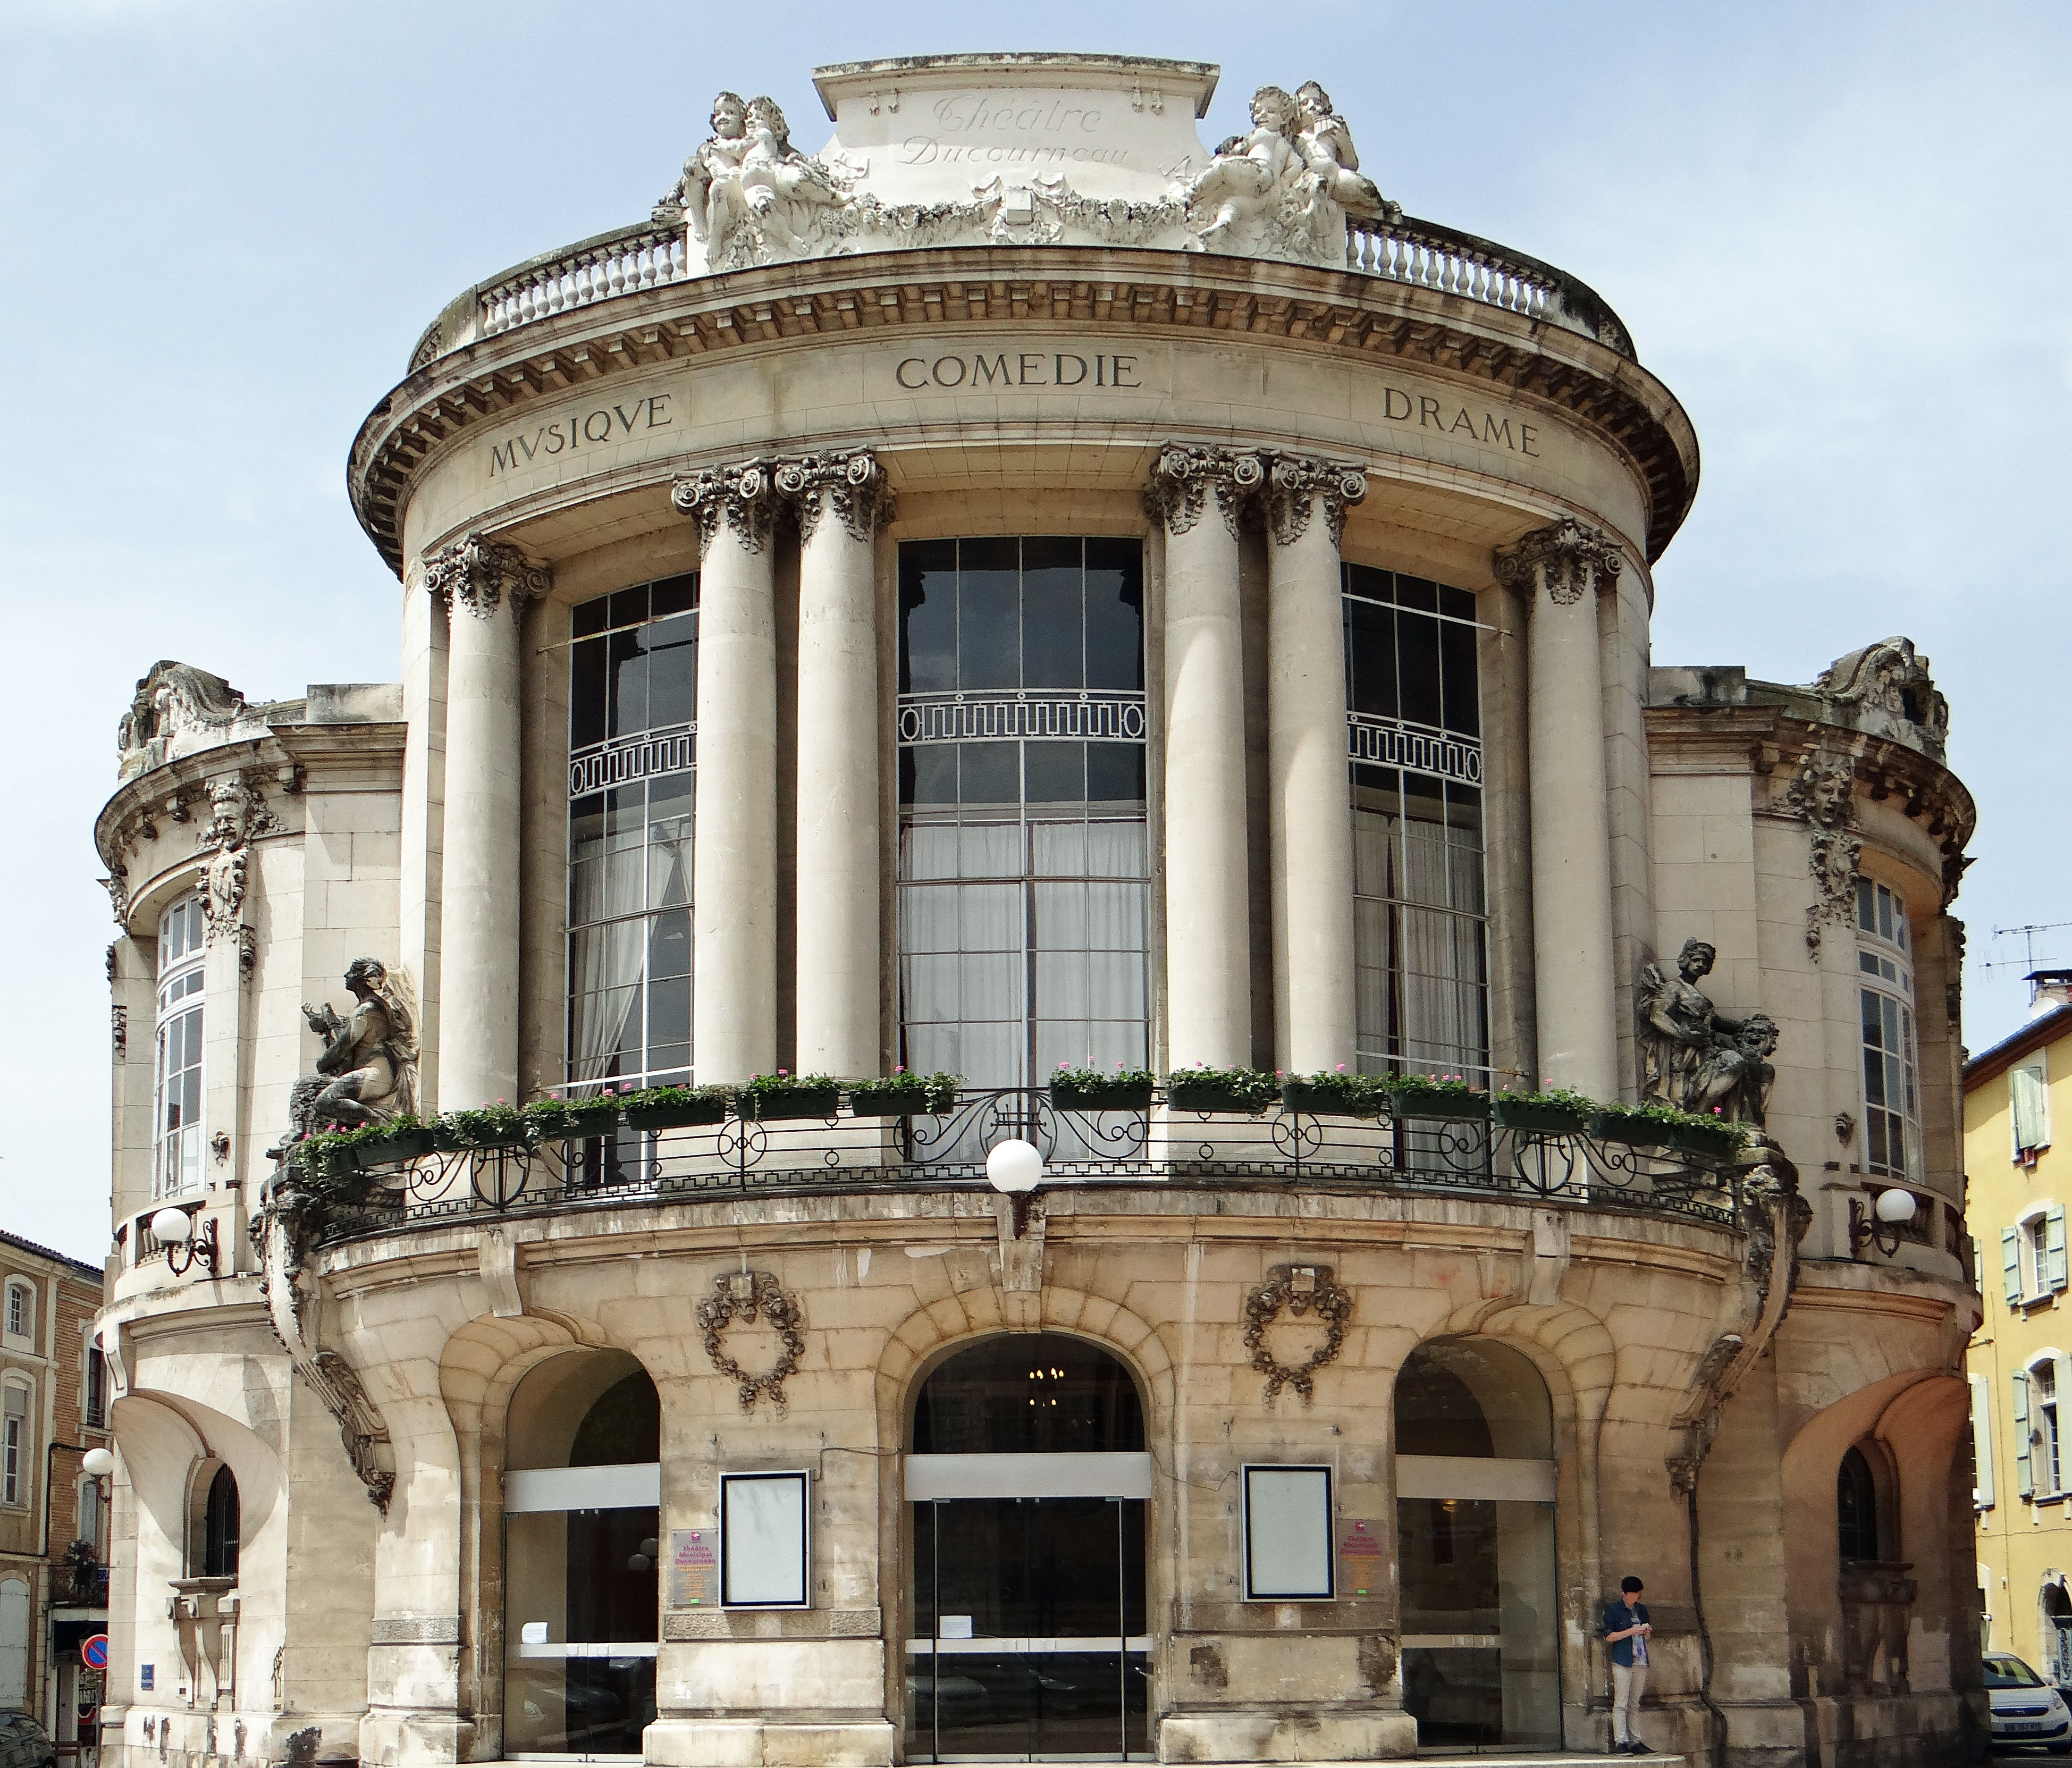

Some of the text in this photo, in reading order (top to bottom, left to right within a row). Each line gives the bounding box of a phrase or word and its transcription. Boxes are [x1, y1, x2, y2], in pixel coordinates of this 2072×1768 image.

[933, 95, 1101, 132] Théâtre
[897, 136, 1128, 165] Ducourneau
[896, 353, 1142, 389] COMEDIE
[490, 394, 672, 477] MVSIQVE
[1383, 387, 1539, 458] DRAME
